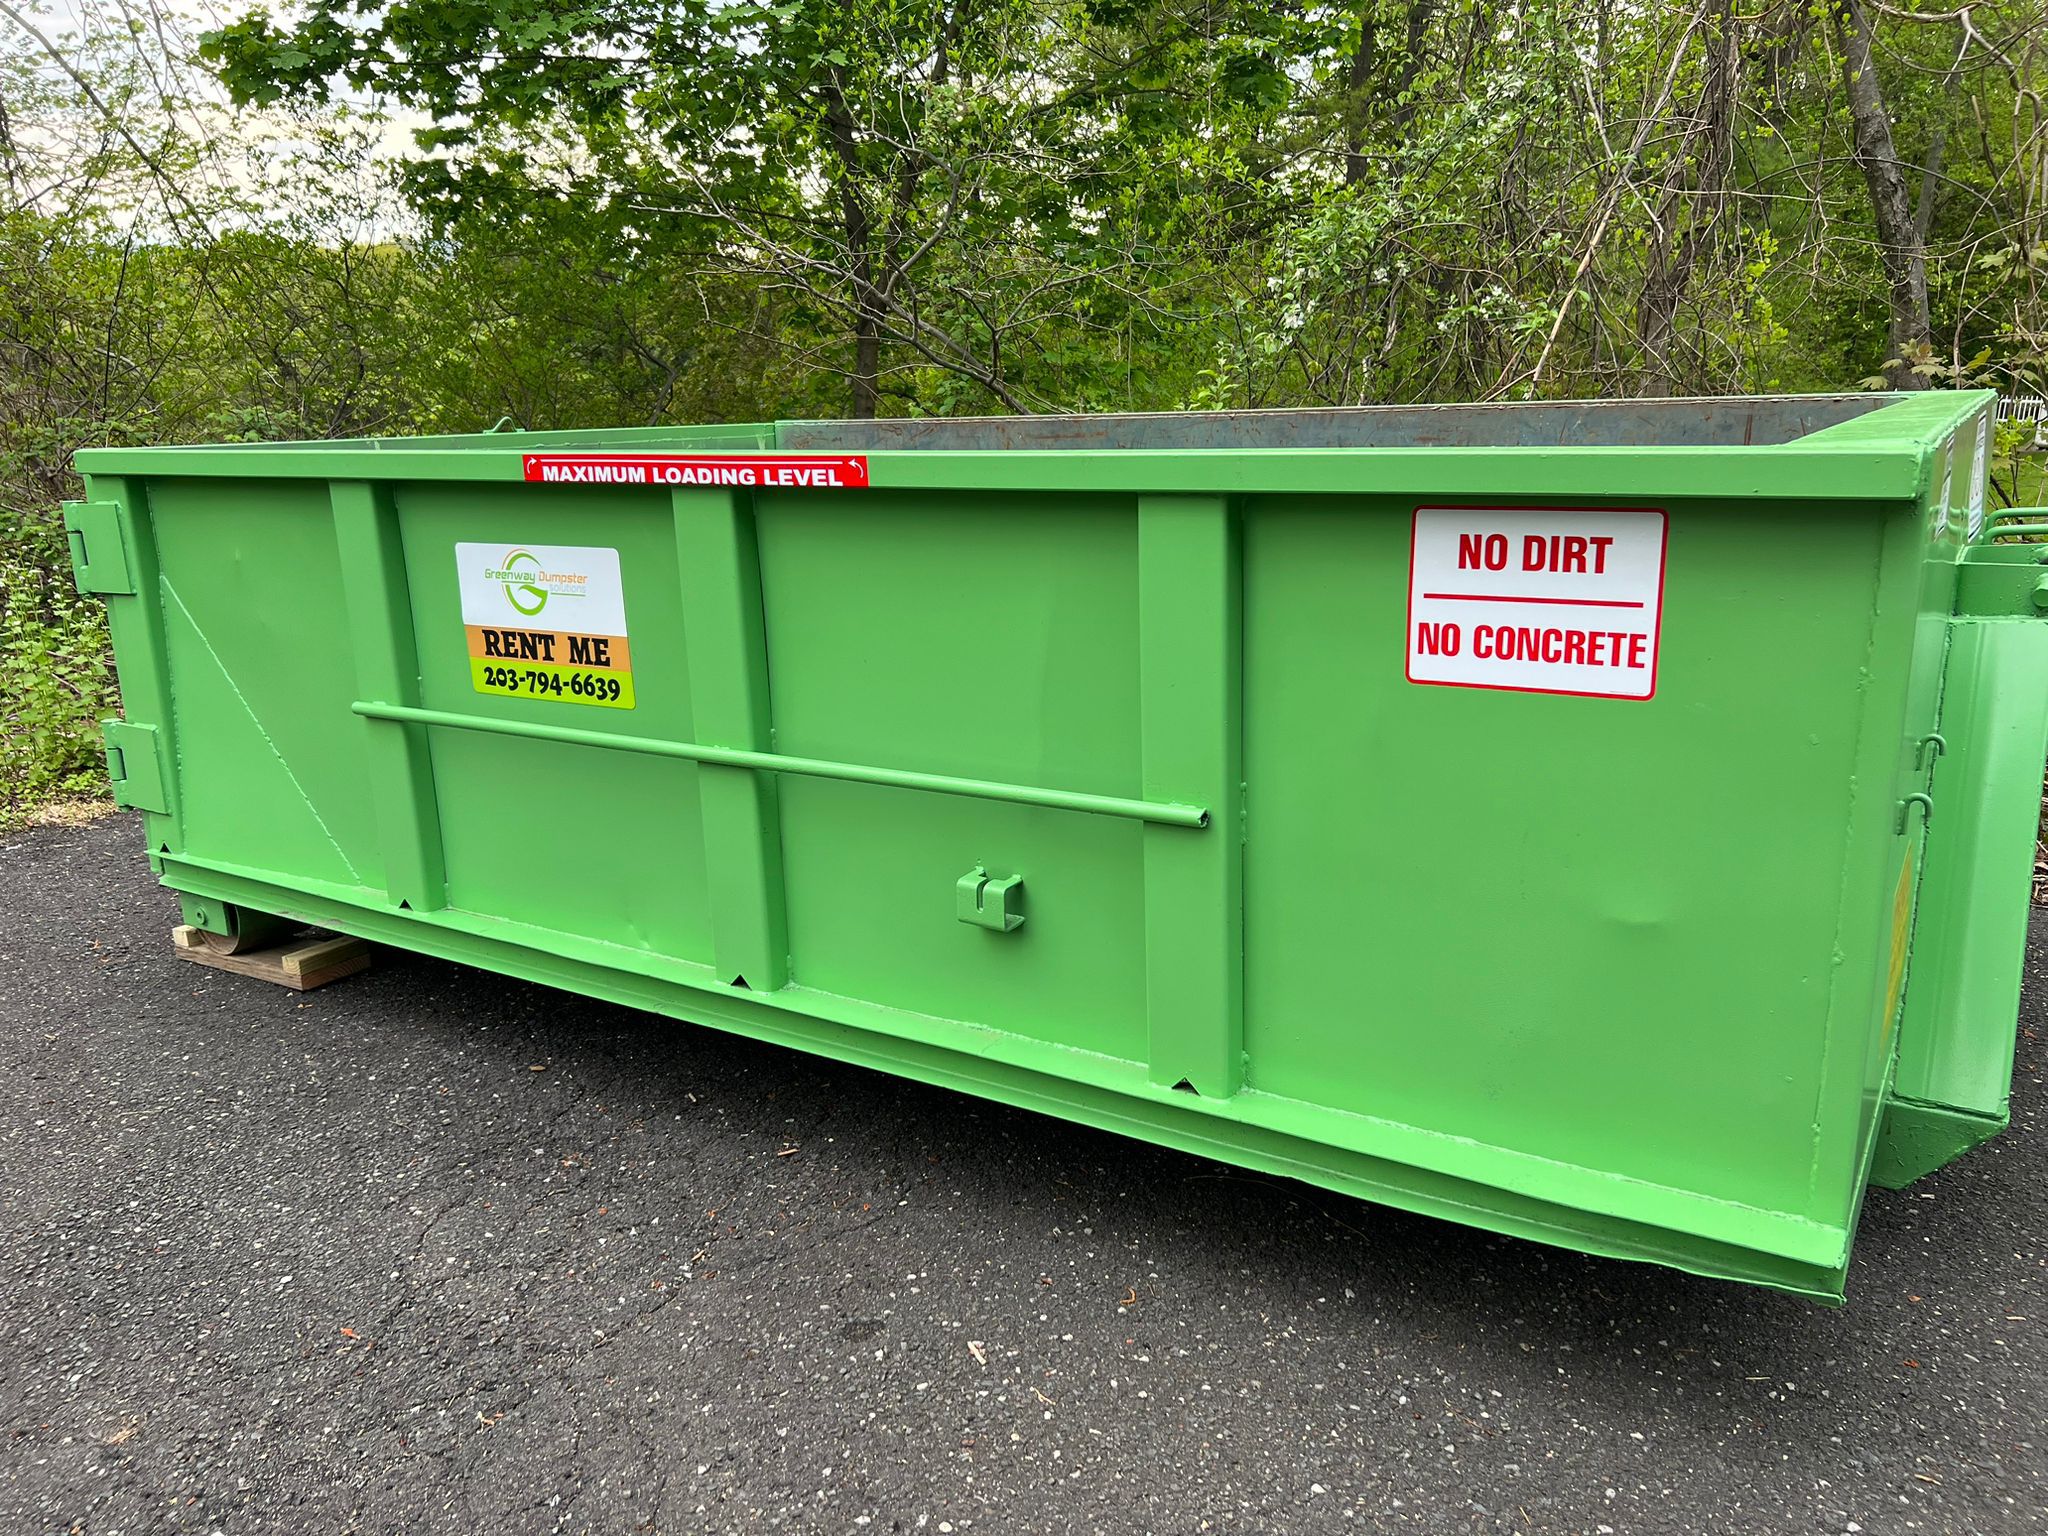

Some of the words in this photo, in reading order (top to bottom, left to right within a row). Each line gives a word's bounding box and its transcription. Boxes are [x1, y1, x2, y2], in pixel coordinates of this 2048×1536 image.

[542, 465, 646, 483] MAXIMUM
[653, 467, 756, 485] LOADING
[764, 469, 843, 486] LEVEL
[1458, 533, 1508, 571] NO
[1522, 535, 1613, 574] DIRT
[484, 568, 536, 584] Greenway
[538, 570, 588, 584] Dumpster
[481, 629, 556, 662] RENT
[567, 636, 611, 667] ME
[1417, 622, 1461, 657] NO
[1473, 624, 1647, 668] CONCRETE
[483, 666, 621, 702] 203-794-6639
